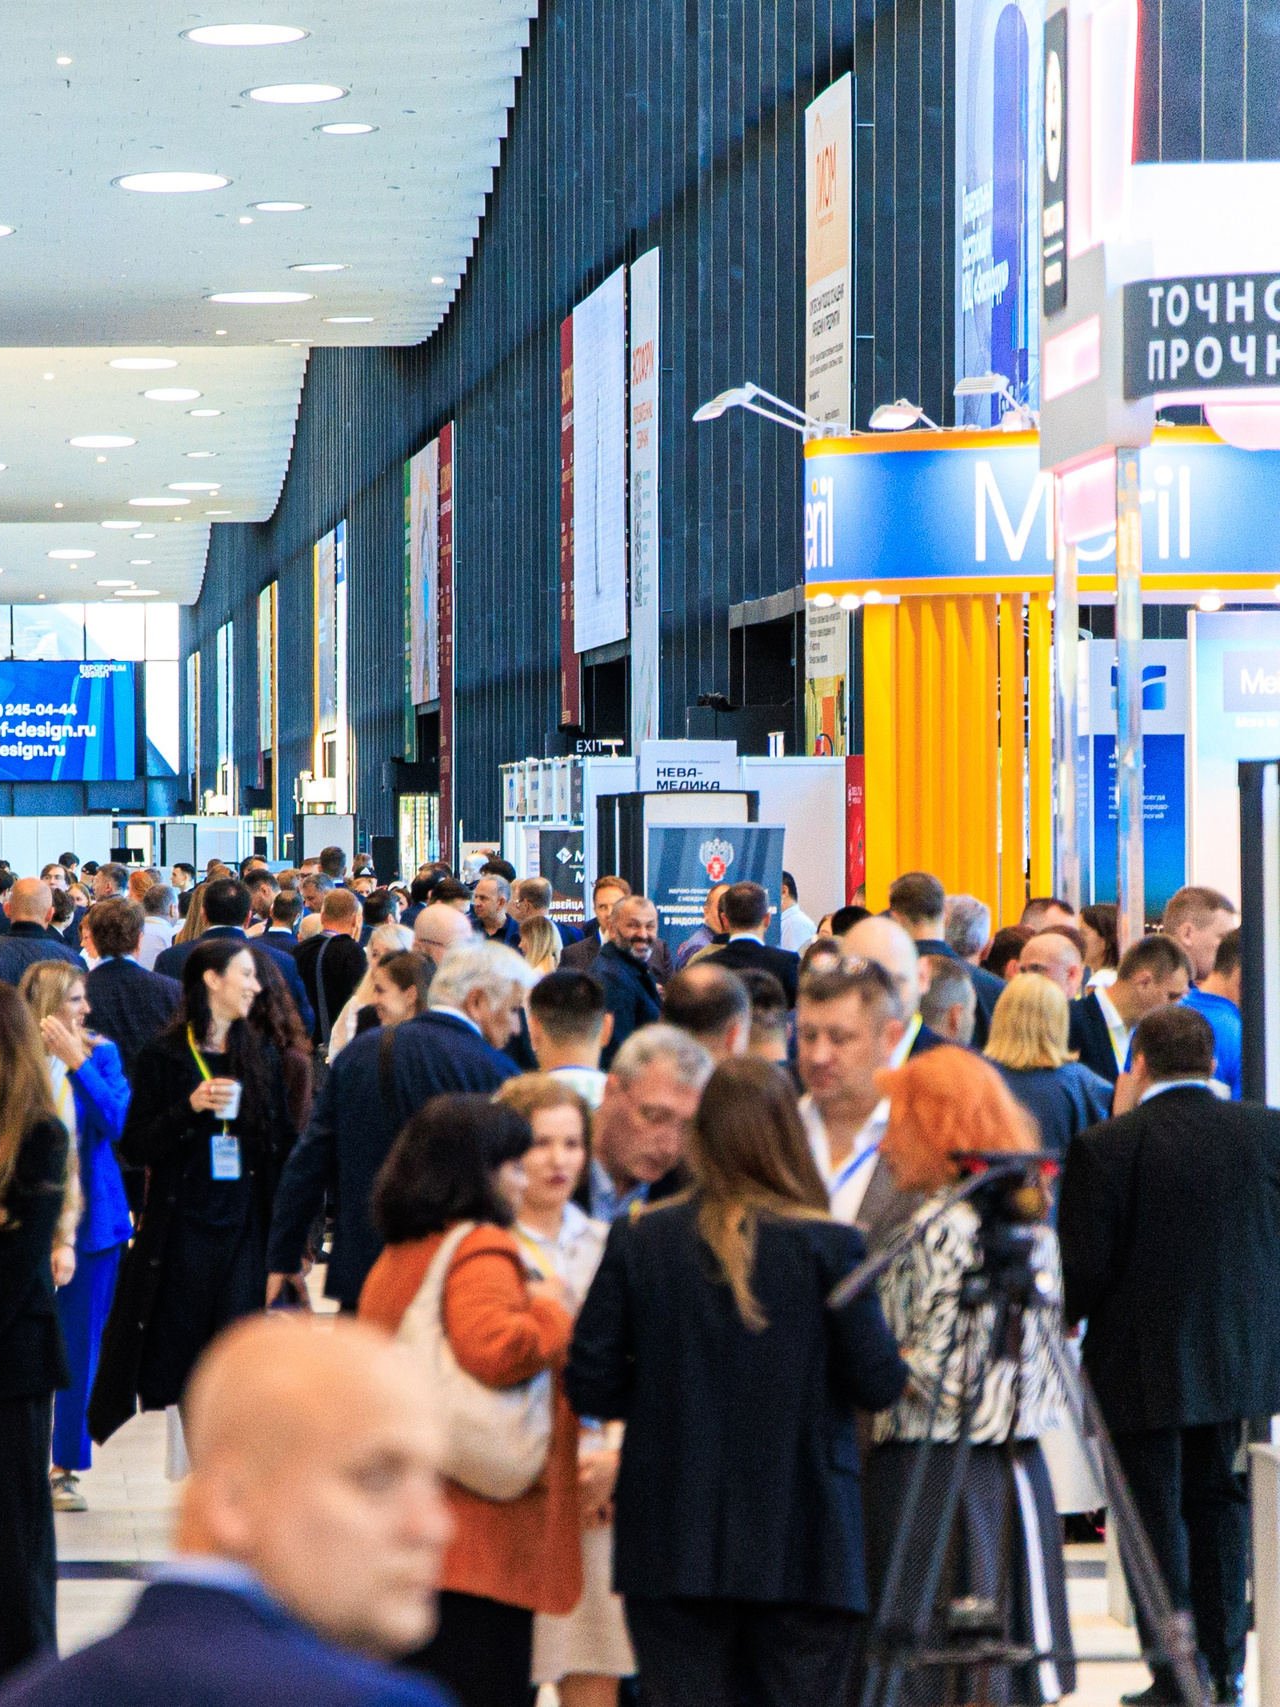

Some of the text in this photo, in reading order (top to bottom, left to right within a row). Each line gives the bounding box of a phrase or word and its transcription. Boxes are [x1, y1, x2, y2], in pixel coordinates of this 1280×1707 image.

[975, 460, 1190, 562] Mil
[5, 703, 78, 716] 245-04-44
[576, 740, 603, 753] EXIT
[656, 767, 703, 777] НЕВА-
[656, 780, 720, 790] МЕДИКА
